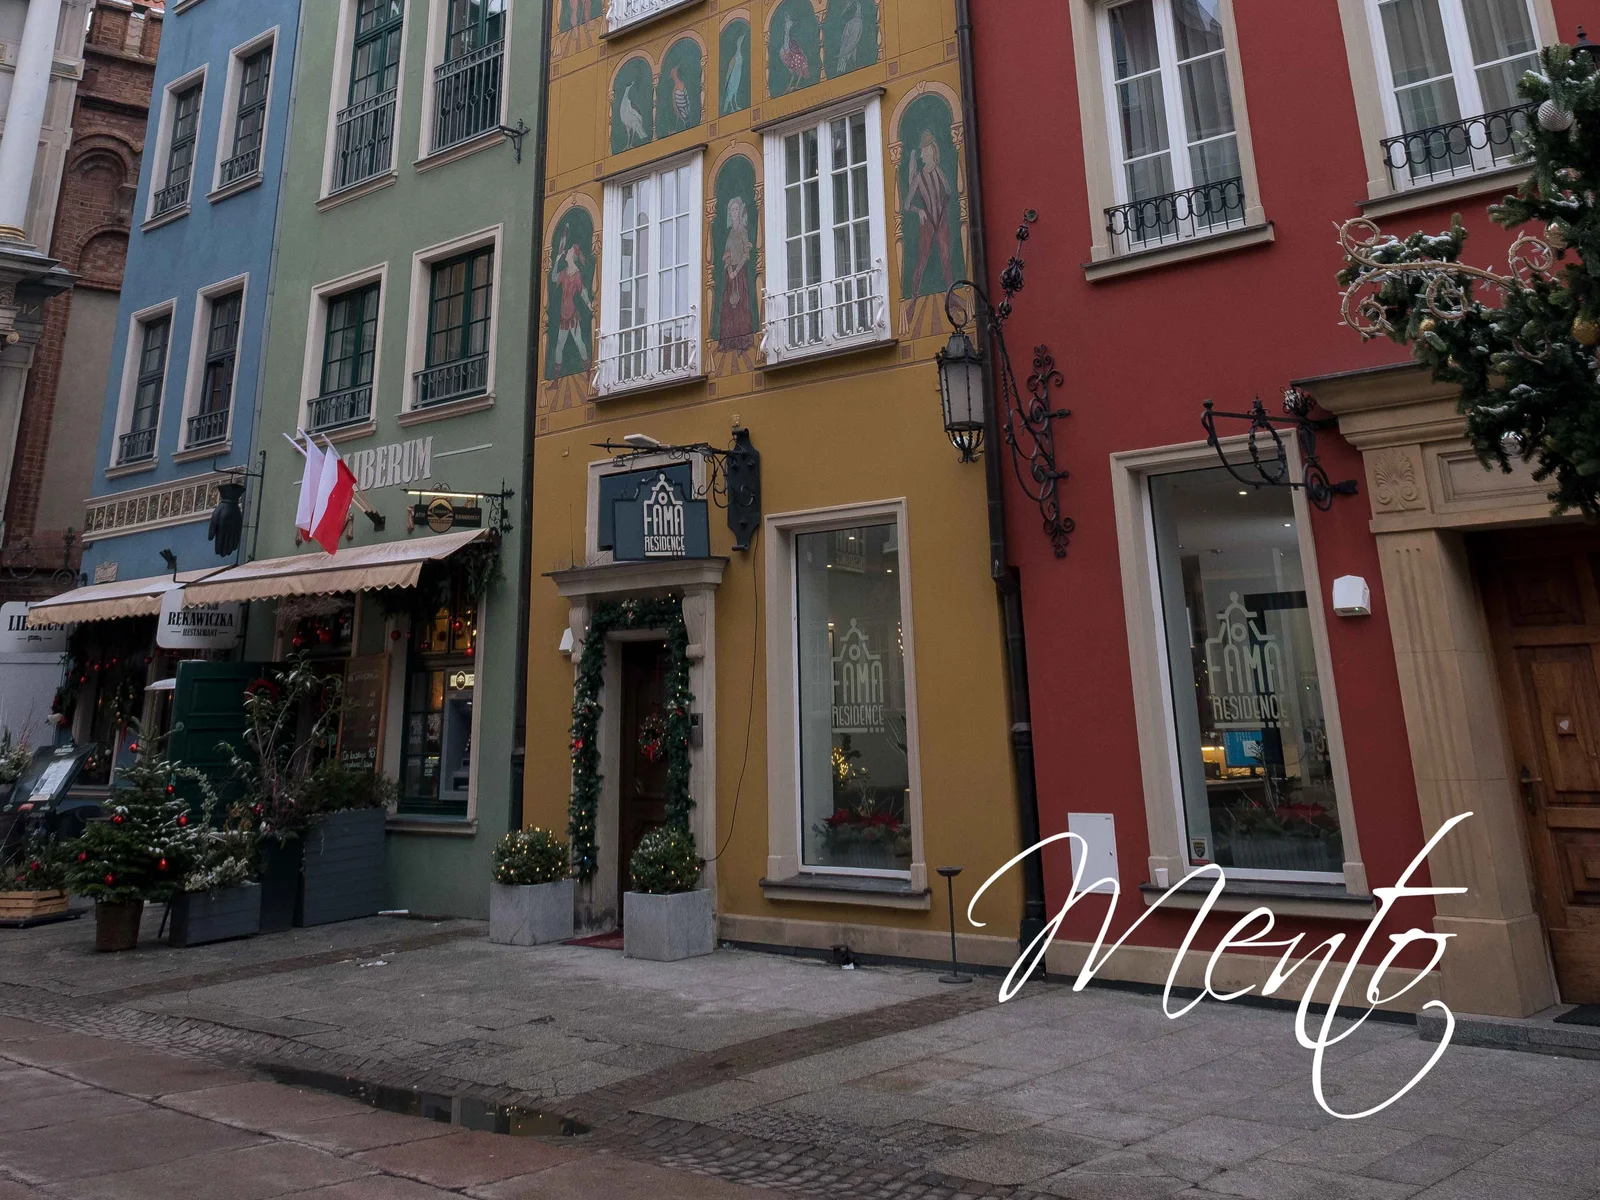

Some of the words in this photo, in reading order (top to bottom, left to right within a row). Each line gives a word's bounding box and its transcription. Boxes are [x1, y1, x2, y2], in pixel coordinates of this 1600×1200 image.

[643, 501, 685, 535] FAMA
[644, 536, 685, 552] RESIDENCE
[167, 611, 233, 627] RĘKAWICZKA
[182, 628, 218, 637] RESTAURANT
[1205, 638, 1285, 693] FAMA
[831, 658, 884, 704] FAMA
[832, 704, 884, 726] RESIDENCE
[1213, 694, 1288, 720] RESIDENCE
